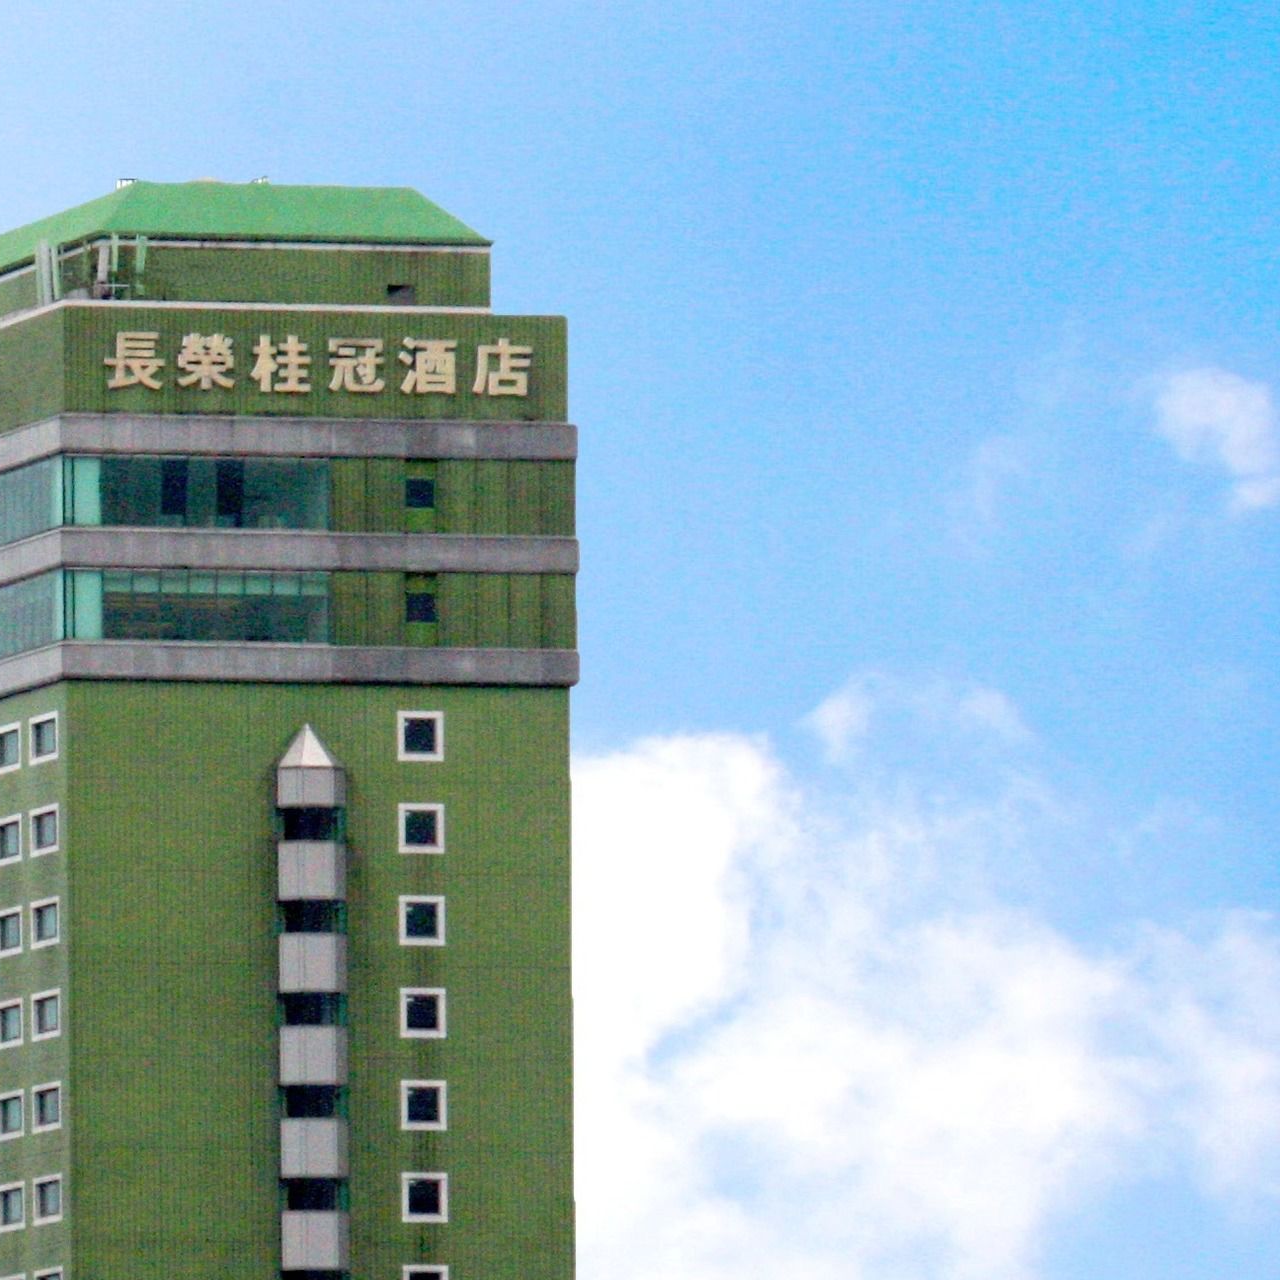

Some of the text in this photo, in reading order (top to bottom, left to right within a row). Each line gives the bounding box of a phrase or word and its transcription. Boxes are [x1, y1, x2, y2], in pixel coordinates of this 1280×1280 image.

[103, 331, 533, 397] 長榮桂冠酒店
